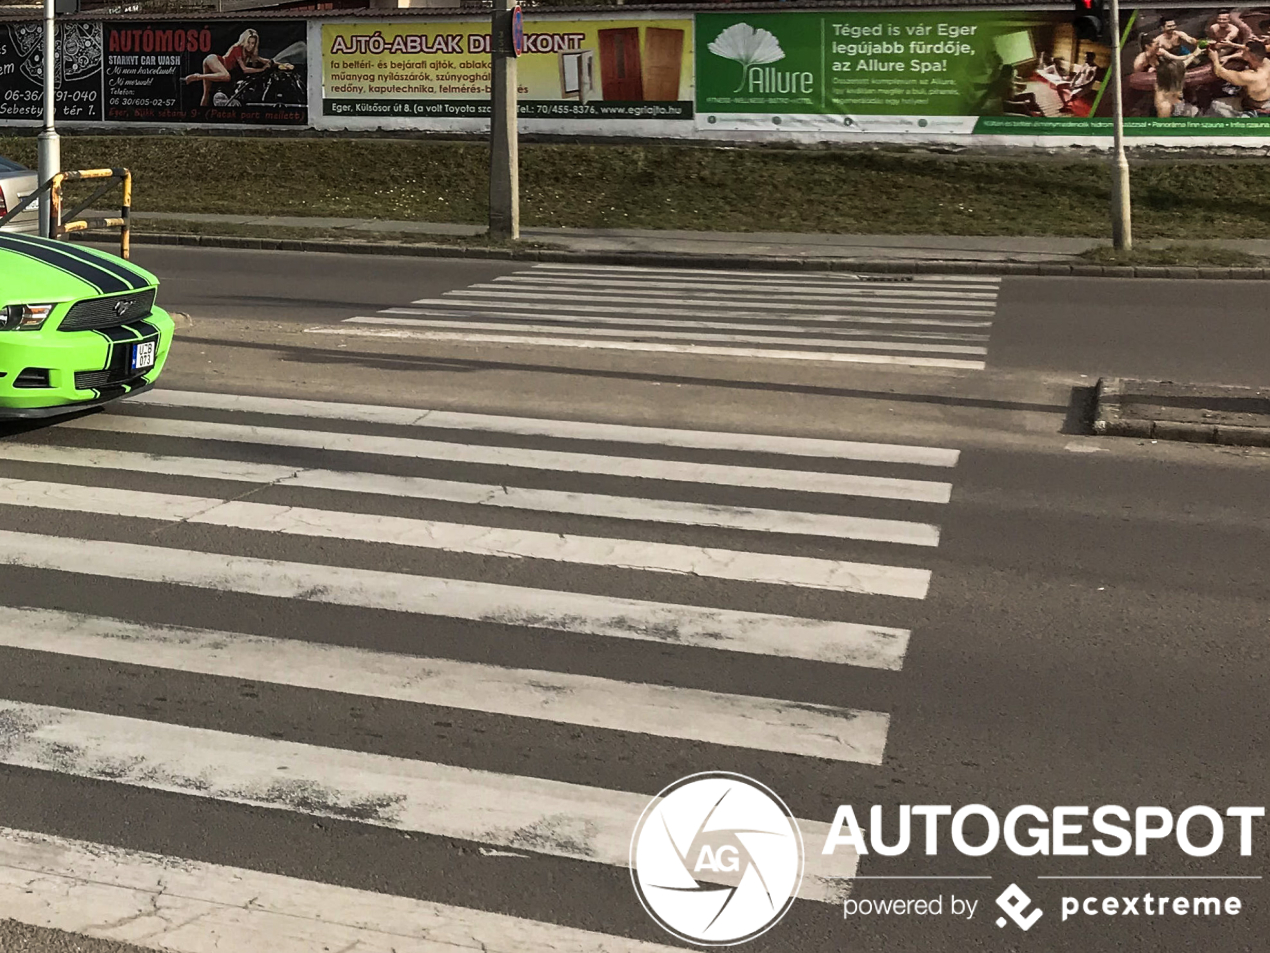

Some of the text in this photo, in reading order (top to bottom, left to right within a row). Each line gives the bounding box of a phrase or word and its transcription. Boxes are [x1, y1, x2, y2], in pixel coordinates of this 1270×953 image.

[832, 23, 977, 38] Téged is vár Eger
[109, 25, 212, 53] AUTÓMOSÓ
[331, 32, 463, 54] AJTÓ-ABLAK
[468, 34, 585, 54] DIKONT
[832, 41, 975, 56] legújabb fürdője,
[140, 56, 156, 66] CAR
[158, 56, 180, 66] WASH
[330, 61, 340, 70] fa
[342, 61, 374, 70] beltéri-
[377, 61, 387, 70] és
[390, 61, 427, 71] bejárati
[429, 61, 456, 71] ajtók,
[832, 59, 947, 73] az Allure Spa!
[331, 72, 375, 83] műanyag
[377, 72, 433, 83] nyílászárók,
[748, 67, 813, 94] Allure
[4, 90, 97, 101] 06-36/91-040
[110, 88, 135, 96] Telefon:
[331, 84, 366, 94] redőny,
[369, 84, 437, 95] kaputechnika,
[109, 97, 176, 106] 06 30/605-02-57
[63, 103, 82, 115] tér
[88, 105, 96, 116] 1.
[265, 109, 305, 121] mellett)
[332, 103, 353, 114] Eger,
[355, 103, 390, 113] Külsősor
[393, 103, 402, 113] út
[404, 104, 412, 113] 8.
[414, 104, 424, 115] (a
[426, 104, 442, 113] volt
[444, 104, 476, 115] Toyota
[600, 105, 682, 116] www.egriajto.hu
[139, 343, 152, 355] UZB
[139, 354, 151, 366] 073
